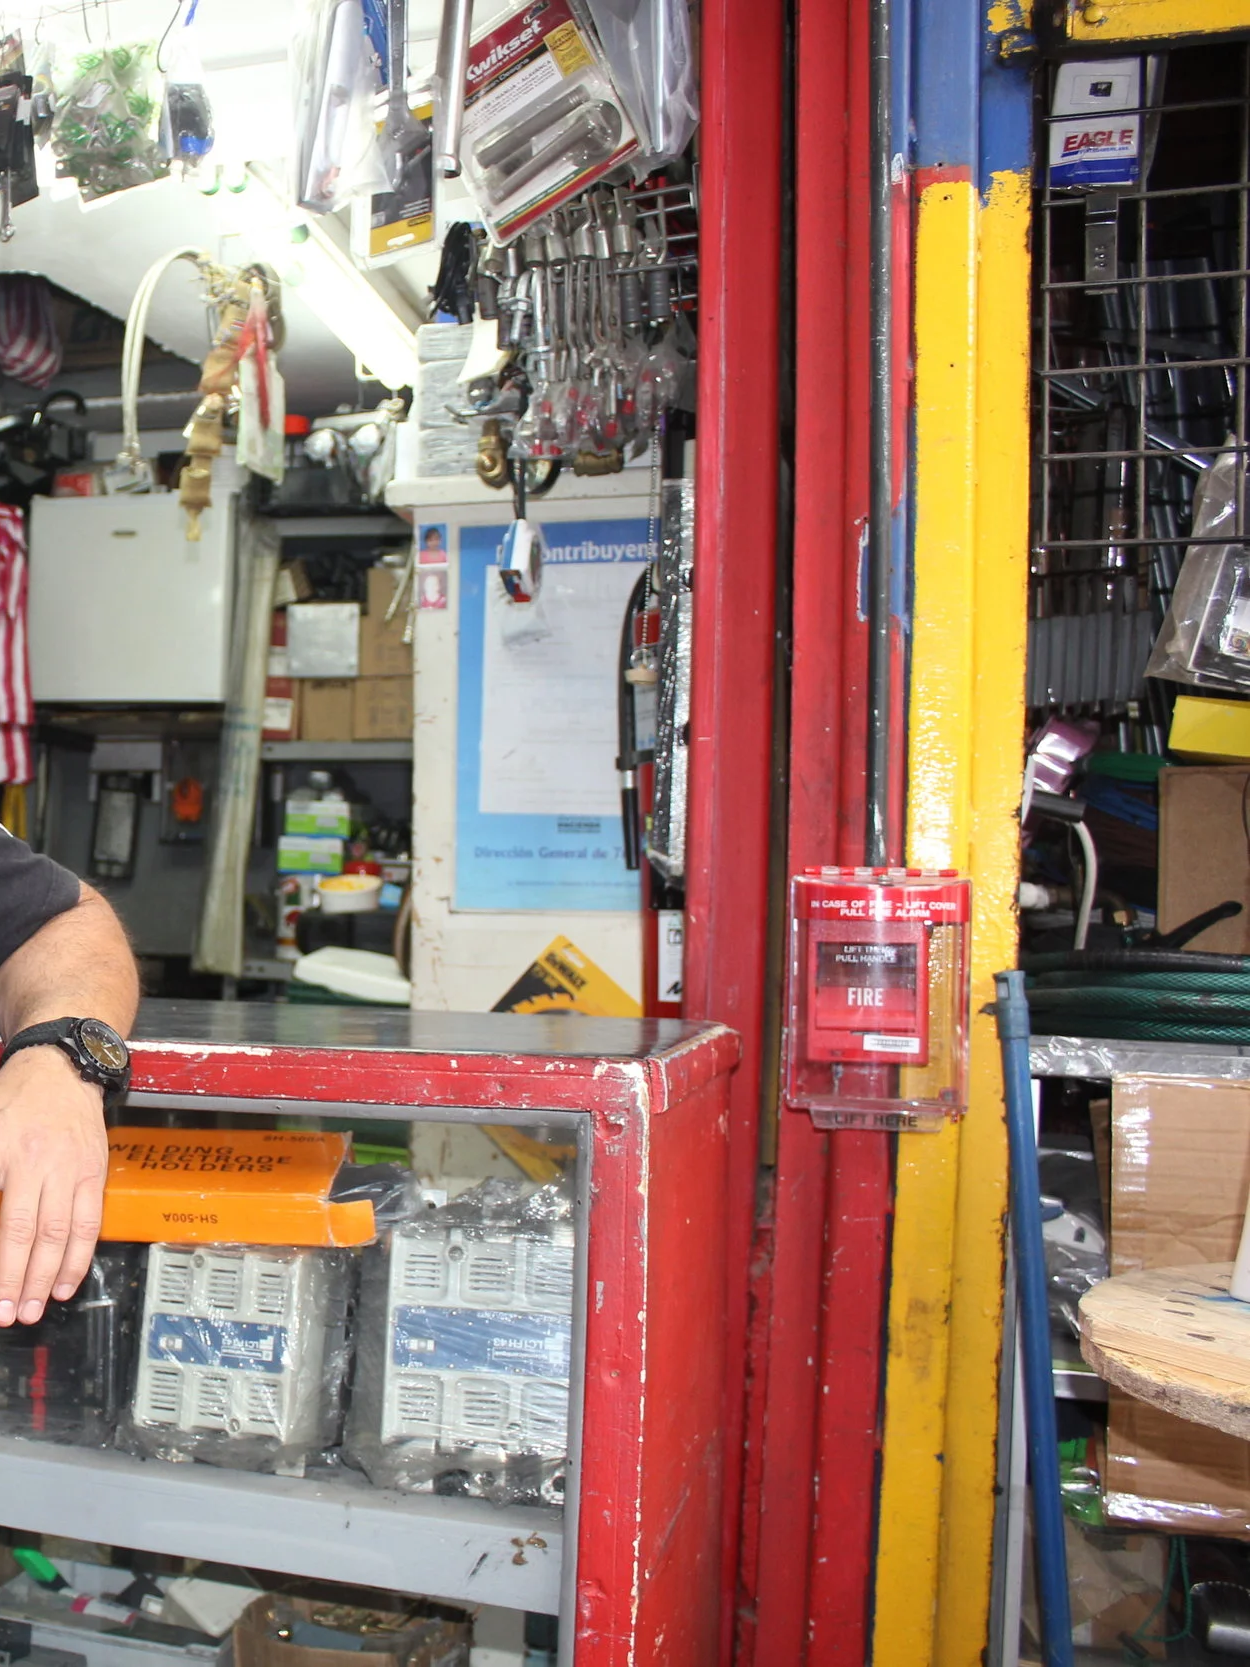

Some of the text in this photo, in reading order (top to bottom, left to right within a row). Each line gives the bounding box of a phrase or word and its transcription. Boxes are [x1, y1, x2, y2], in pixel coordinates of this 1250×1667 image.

[1063, 129, 1134, 153] EAGLE
[538, 847, 587, 859] General
[822, 900, 847, 908] CASE
[851, 900, 866, 908] OF
[869, 900, 893, 909] FRE
[905, 901, 927, 909] LIFT
[929, 901, 956, 910] COVER
[869, 909, 892, 917] FRE
[895, 909, 930, 917] ALARM
[836, 954, 896, 963] PULL HANDLE
[847, 987, 884, 1006] FIRE
[834, 1111, 918, 1127] LIFT HERE
[108, 1143, 234, 1155] WELDING
[125, 1152, 293, 1165] ELECTRODE
[139, 1161, 274, 1173] HOLDERS
[162, 1212, 218, 1224] SH-500A
